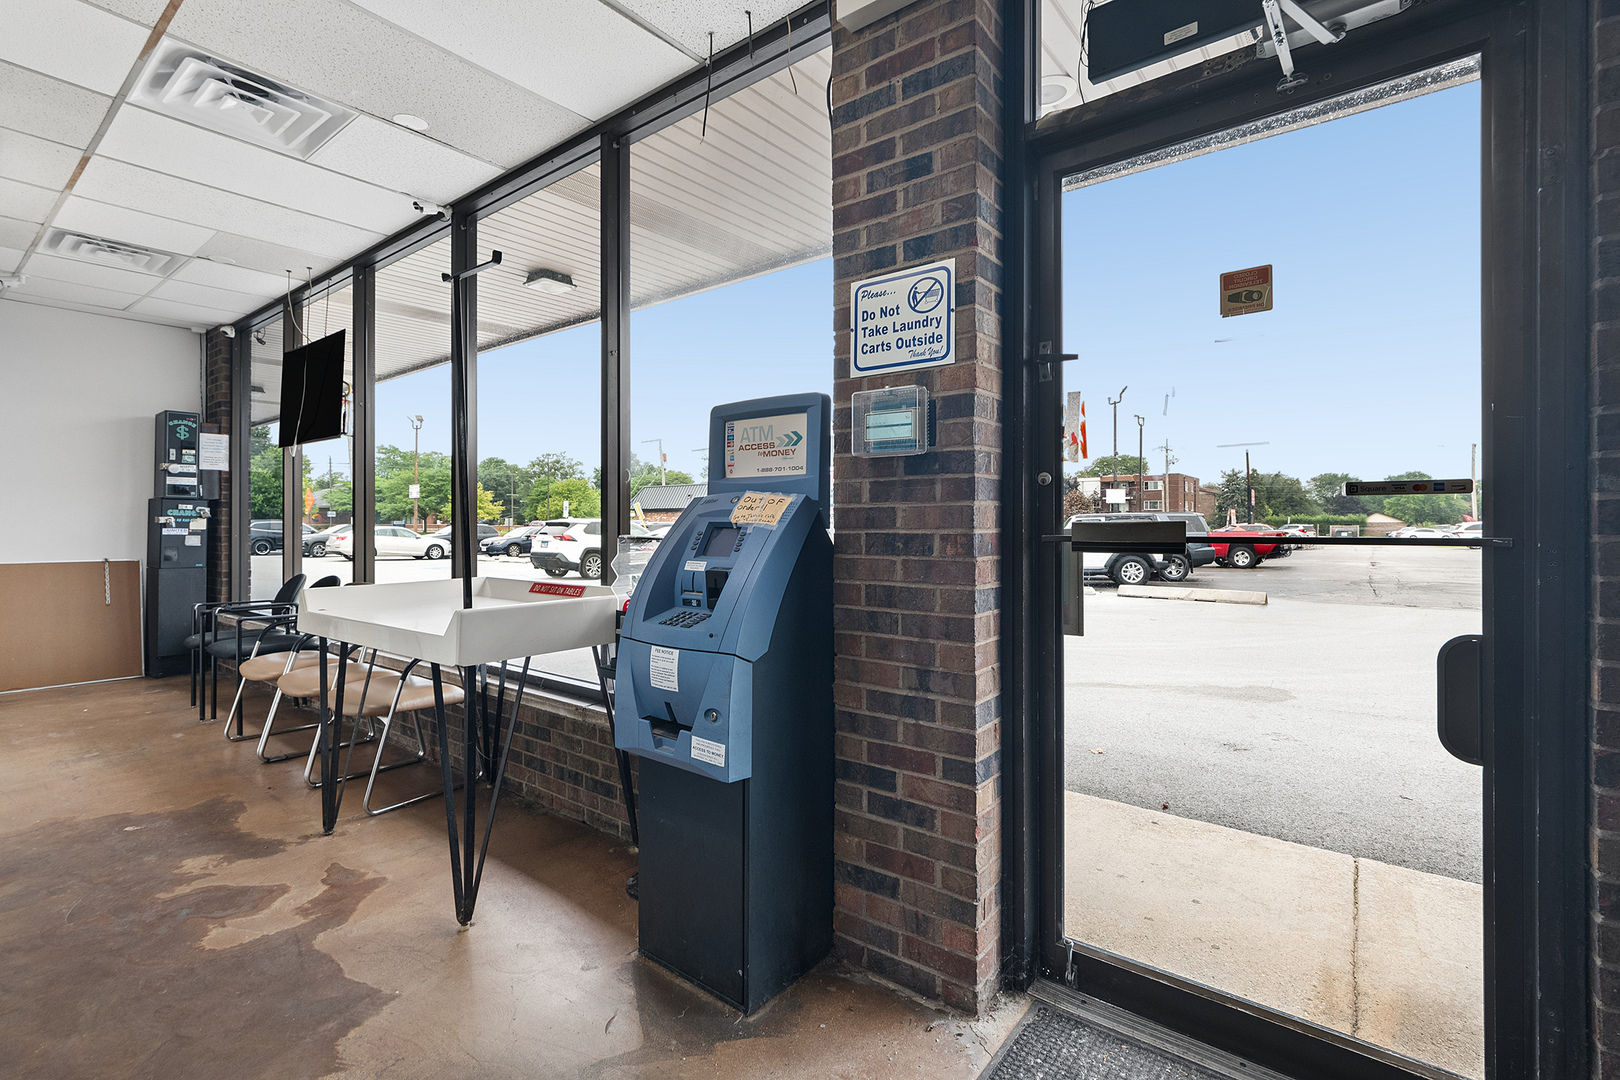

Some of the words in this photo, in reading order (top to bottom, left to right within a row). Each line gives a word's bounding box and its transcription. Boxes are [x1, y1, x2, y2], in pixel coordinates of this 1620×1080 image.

[862, 310, 876, 322] Do
[880, 304, 900, 318] Not
[862, 326, 888, 338] Take
[892, 316, 942, 334] Laundry
[862, 342, 892, 354] Carts
[896, 332, 944, 350] Outside
[908, 348, 926, 358] Thank
[928, 346, 944, 358] You!
[740, 424, 774, 442] ATM
[738, 442, 776, 452] ACCESS
[762, 448, 796, 458] MONEY
